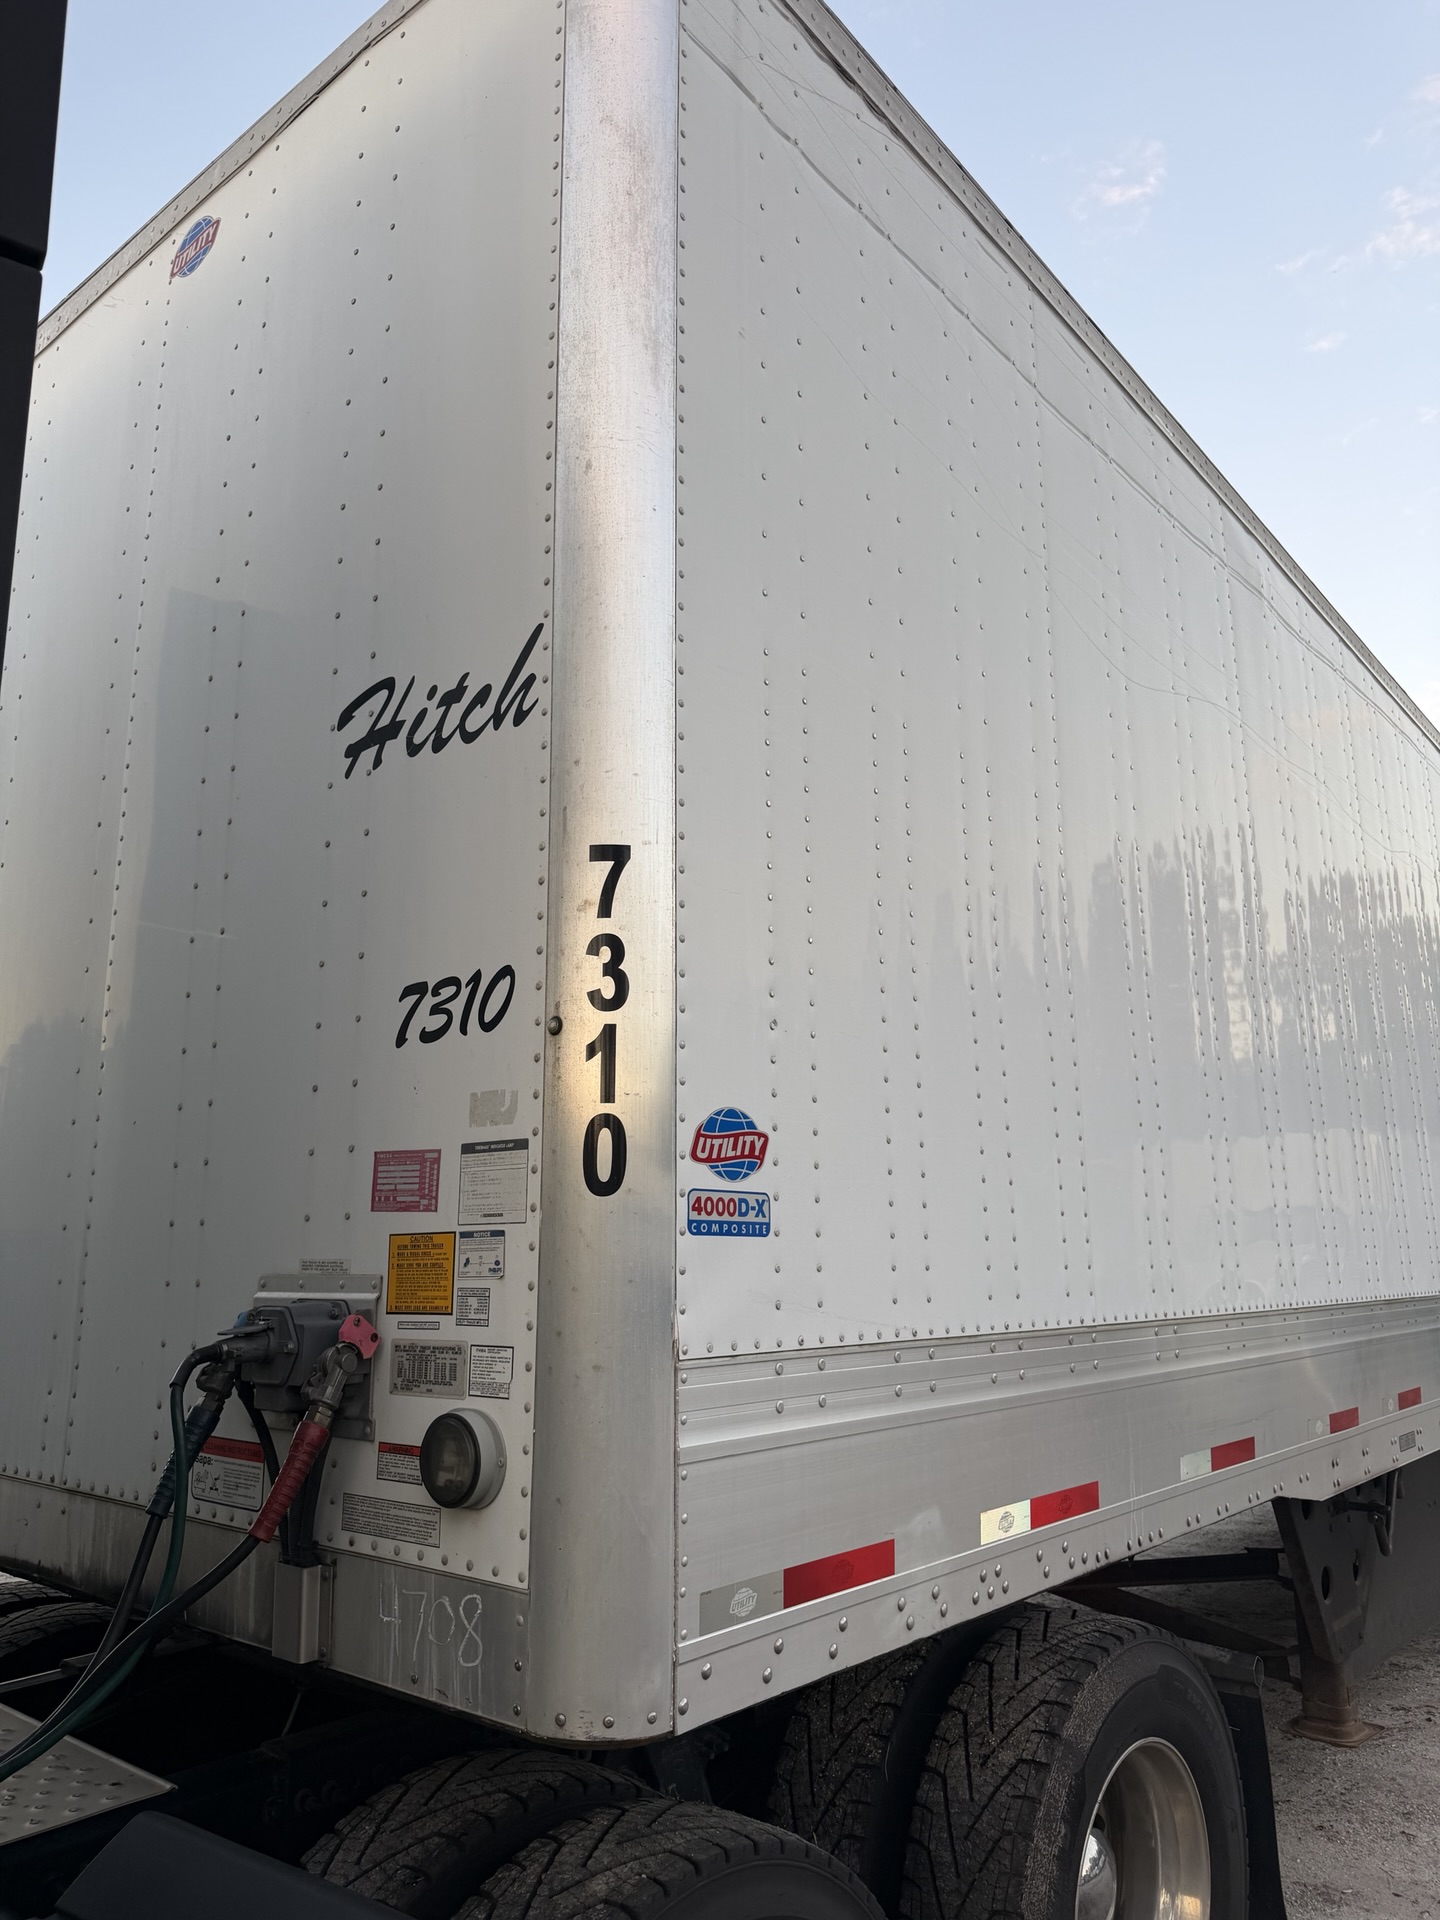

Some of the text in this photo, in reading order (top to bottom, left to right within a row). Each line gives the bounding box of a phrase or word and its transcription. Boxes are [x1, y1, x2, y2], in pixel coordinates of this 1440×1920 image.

[173, 223, 218, 275] UTILITY
[336, 623, 545, 779] Hitch
[395, 964, 515, 1049] 7310
[696, 1134, 765, 1160] UTILITY
[691, 1195, 768, 1219] 4000D-X
[691, 1222, 768, 1235] COMPOSITE
[379, 1583, 483, 1668] 4708
